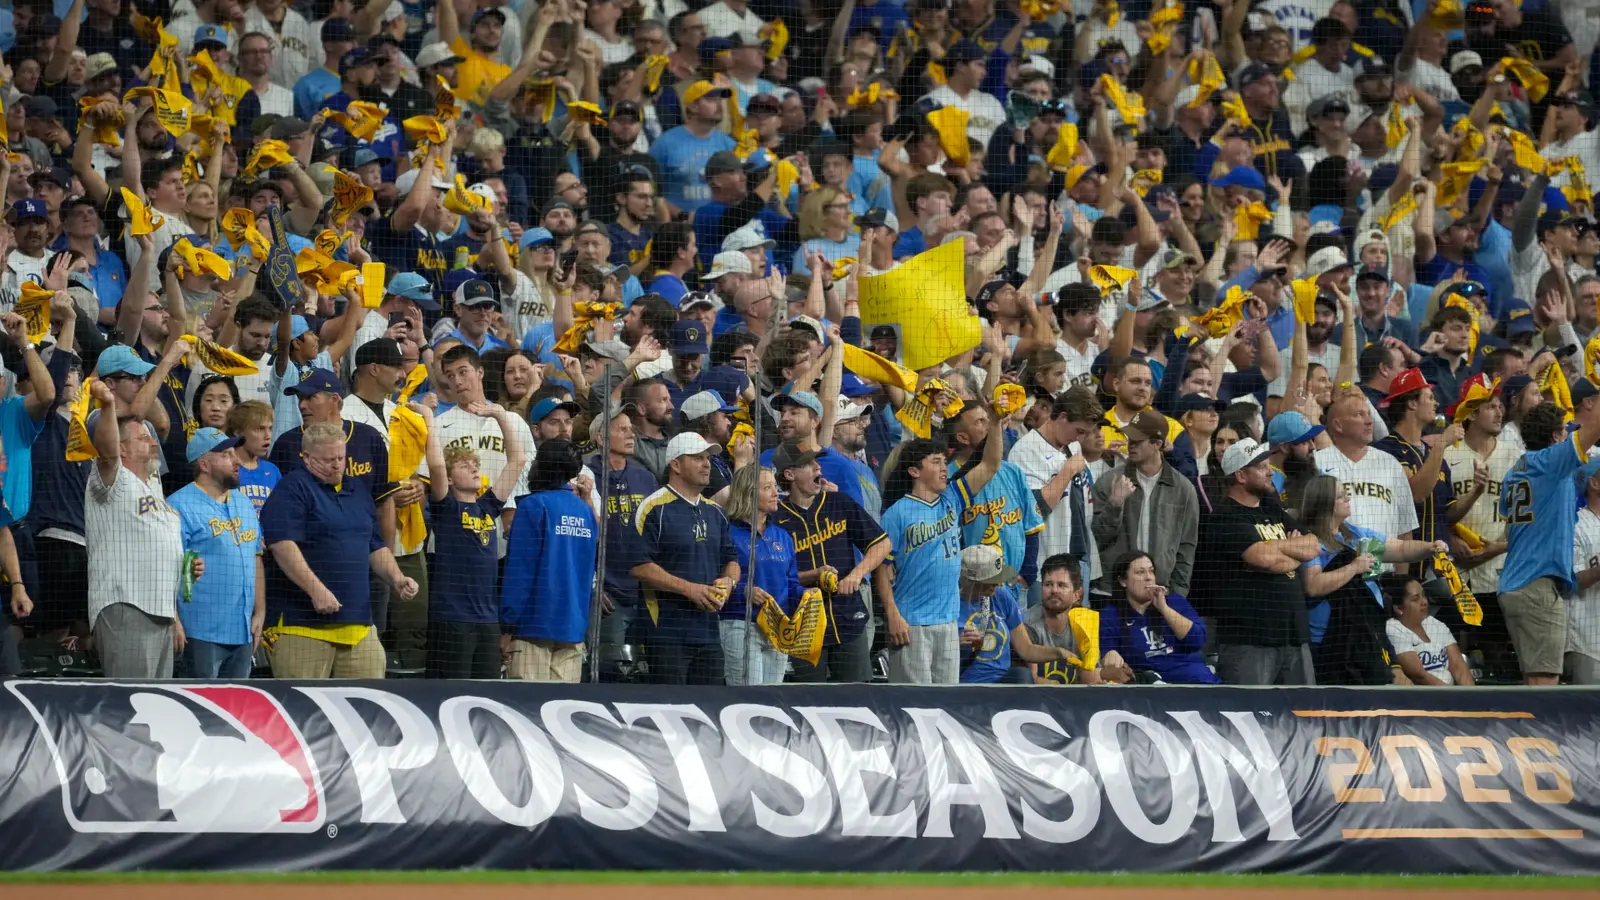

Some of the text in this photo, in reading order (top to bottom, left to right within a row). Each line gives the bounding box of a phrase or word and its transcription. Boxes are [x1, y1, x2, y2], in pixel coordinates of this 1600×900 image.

[208, 515, 242, 537] Brew
[555, 525, 592, 539] SERVICES
[561, 515, 585, 528] EVENT
[230, 526, 258, 547] Crew
[290, 686, 1301, 844] POSTSEASON
[1314, 734, 1575, 804] 2026
